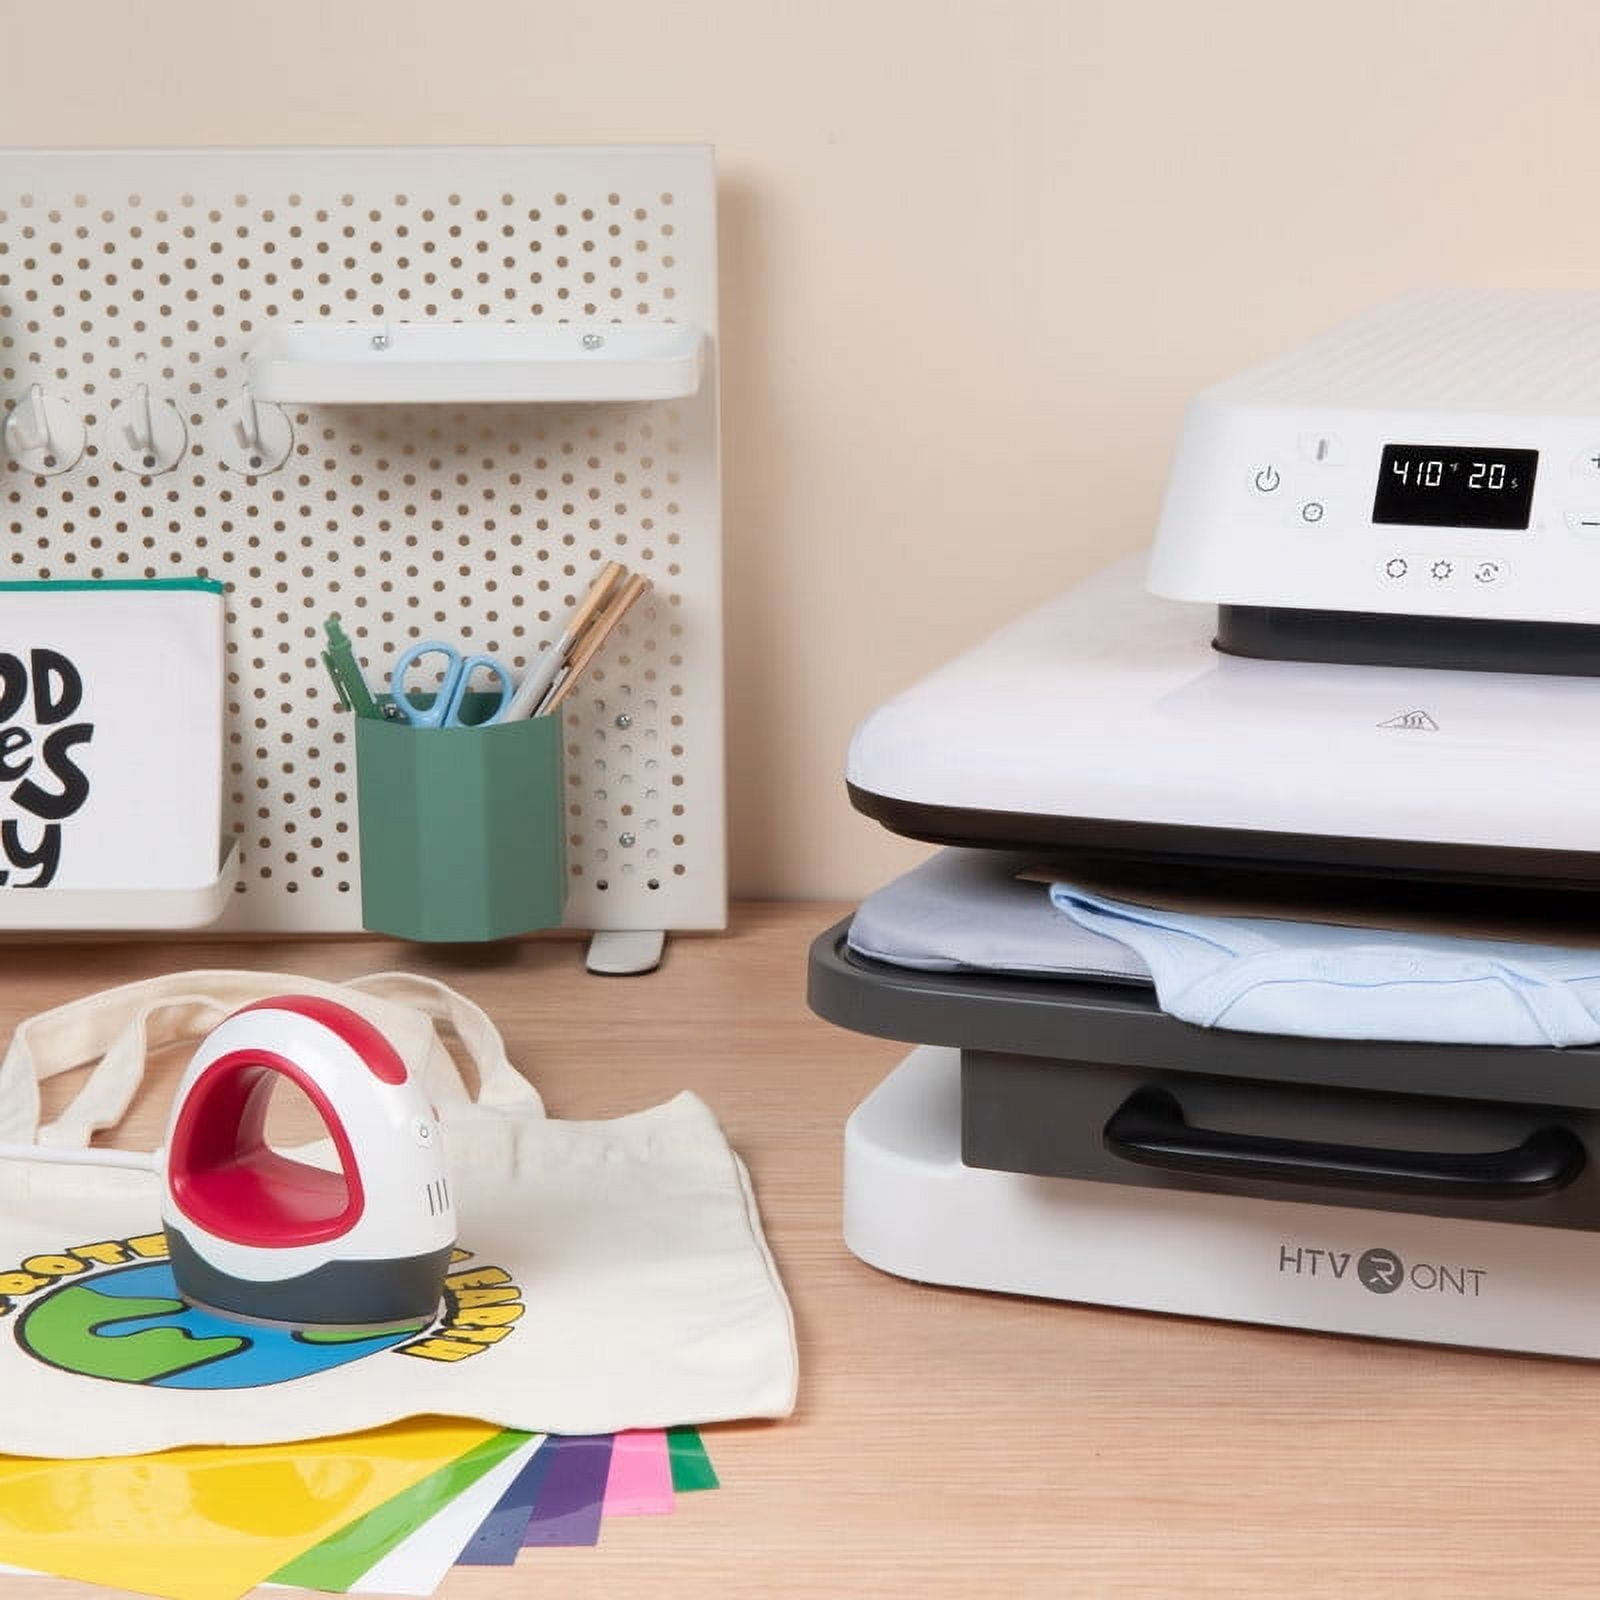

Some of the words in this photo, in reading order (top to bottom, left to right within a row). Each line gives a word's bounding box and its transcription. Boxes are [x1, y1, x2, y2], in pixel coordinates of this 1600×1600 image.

[1393, 460, 1443, 486] 410
[1469, 462, 1506, 489] 20
[1279, 1244, 1488, 1297] HTVRONT
